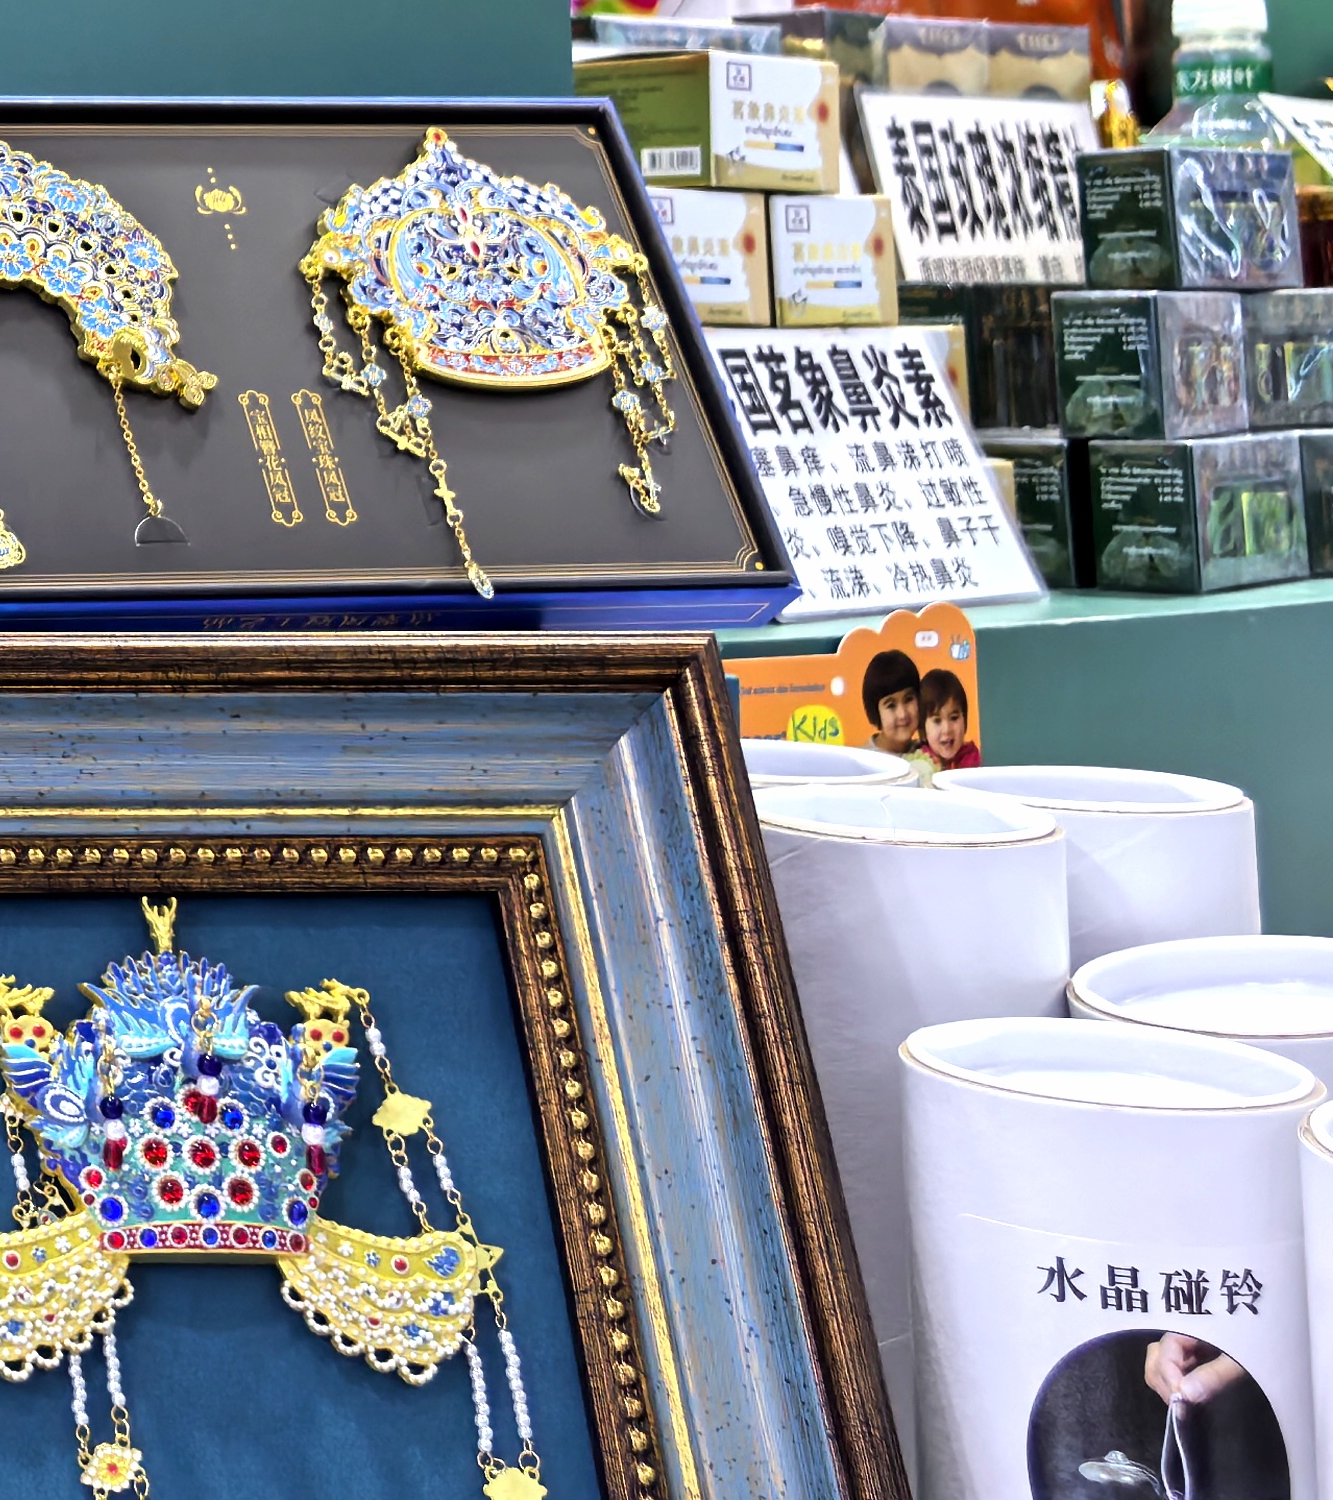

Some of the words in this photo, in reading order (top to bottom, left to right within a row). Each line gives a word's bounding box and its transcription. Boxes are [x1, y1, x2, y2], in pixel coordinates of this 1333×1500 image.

[717, 343, 953, 436] 国茗象鼻炎素
[1037, 1256, 1264, 1316] 水晶碰铃
